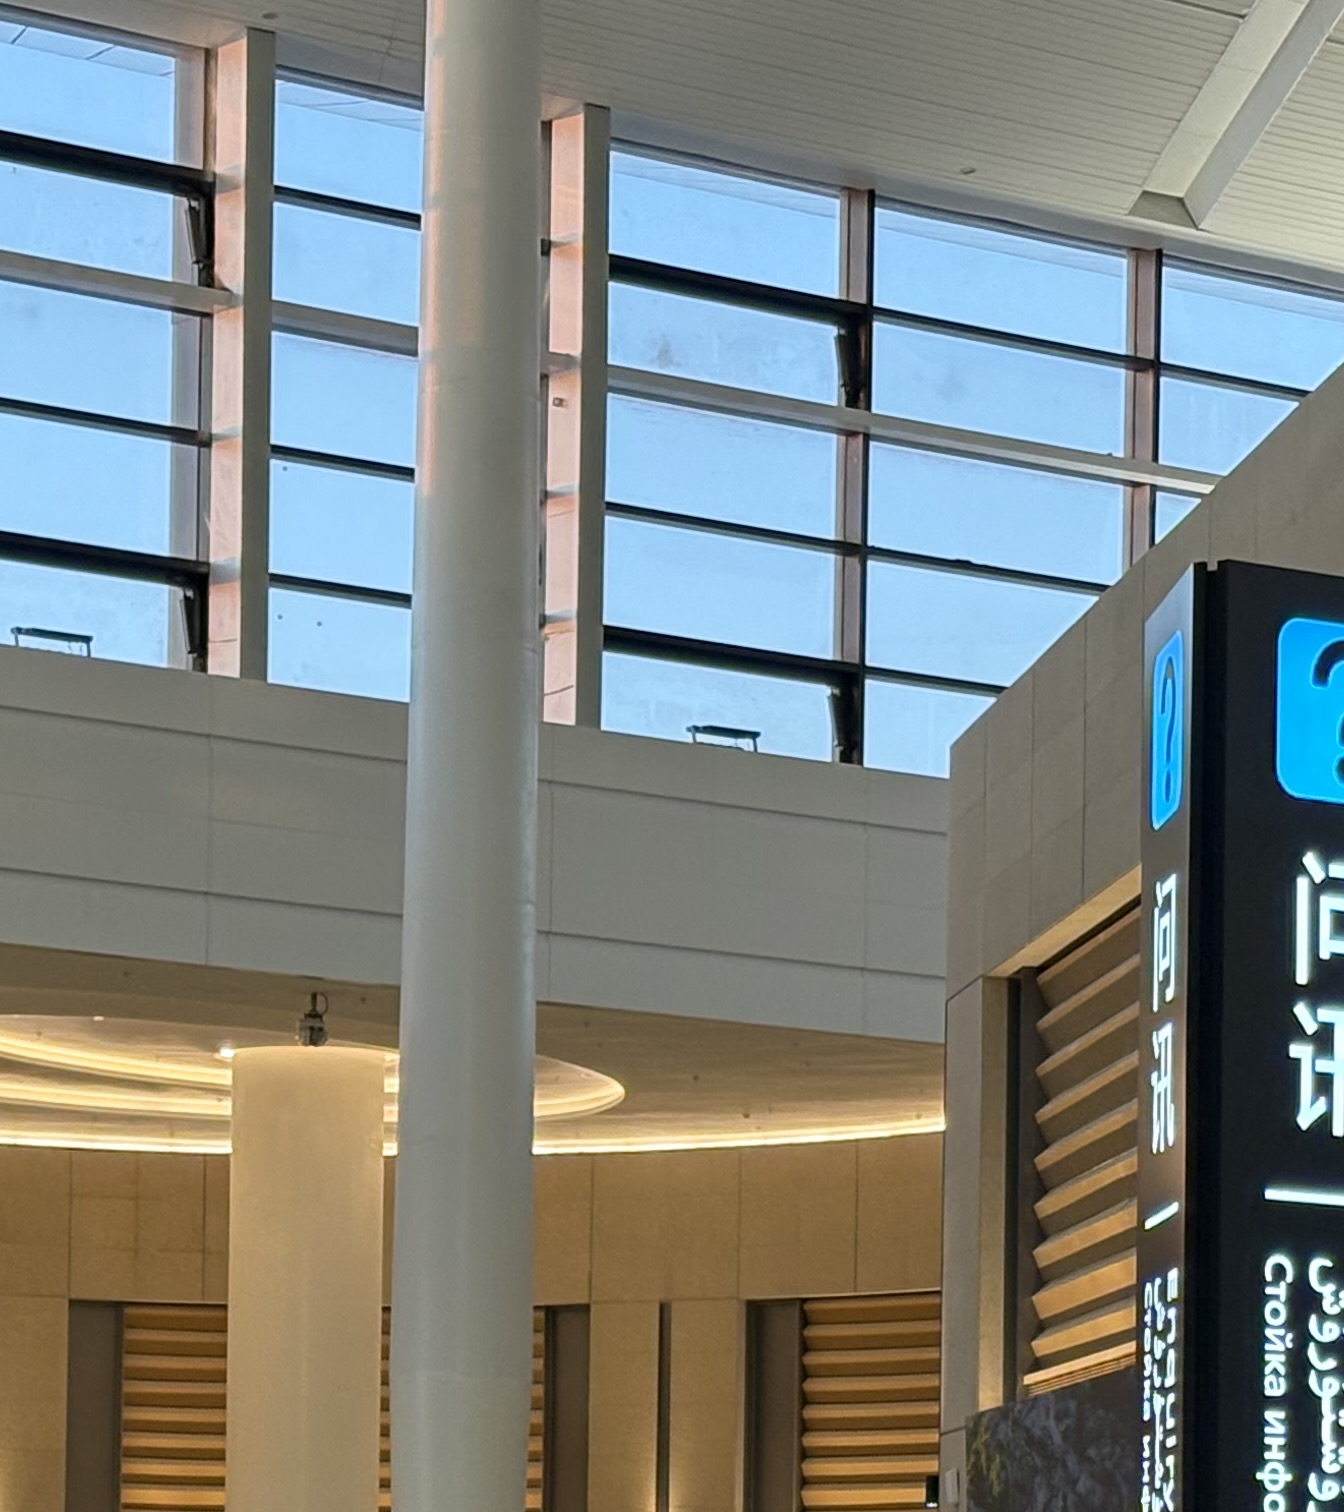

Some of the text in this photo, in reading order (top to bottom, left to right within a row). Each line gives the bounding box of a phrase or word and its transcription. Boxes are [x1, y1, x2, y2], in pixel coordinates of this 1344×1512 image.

[1149, 872, 1178, 1155] 问讯
[1162, 1266, 1179, 1512] Enquiry
[1263, 1252, 1295, 1397] Стойка
